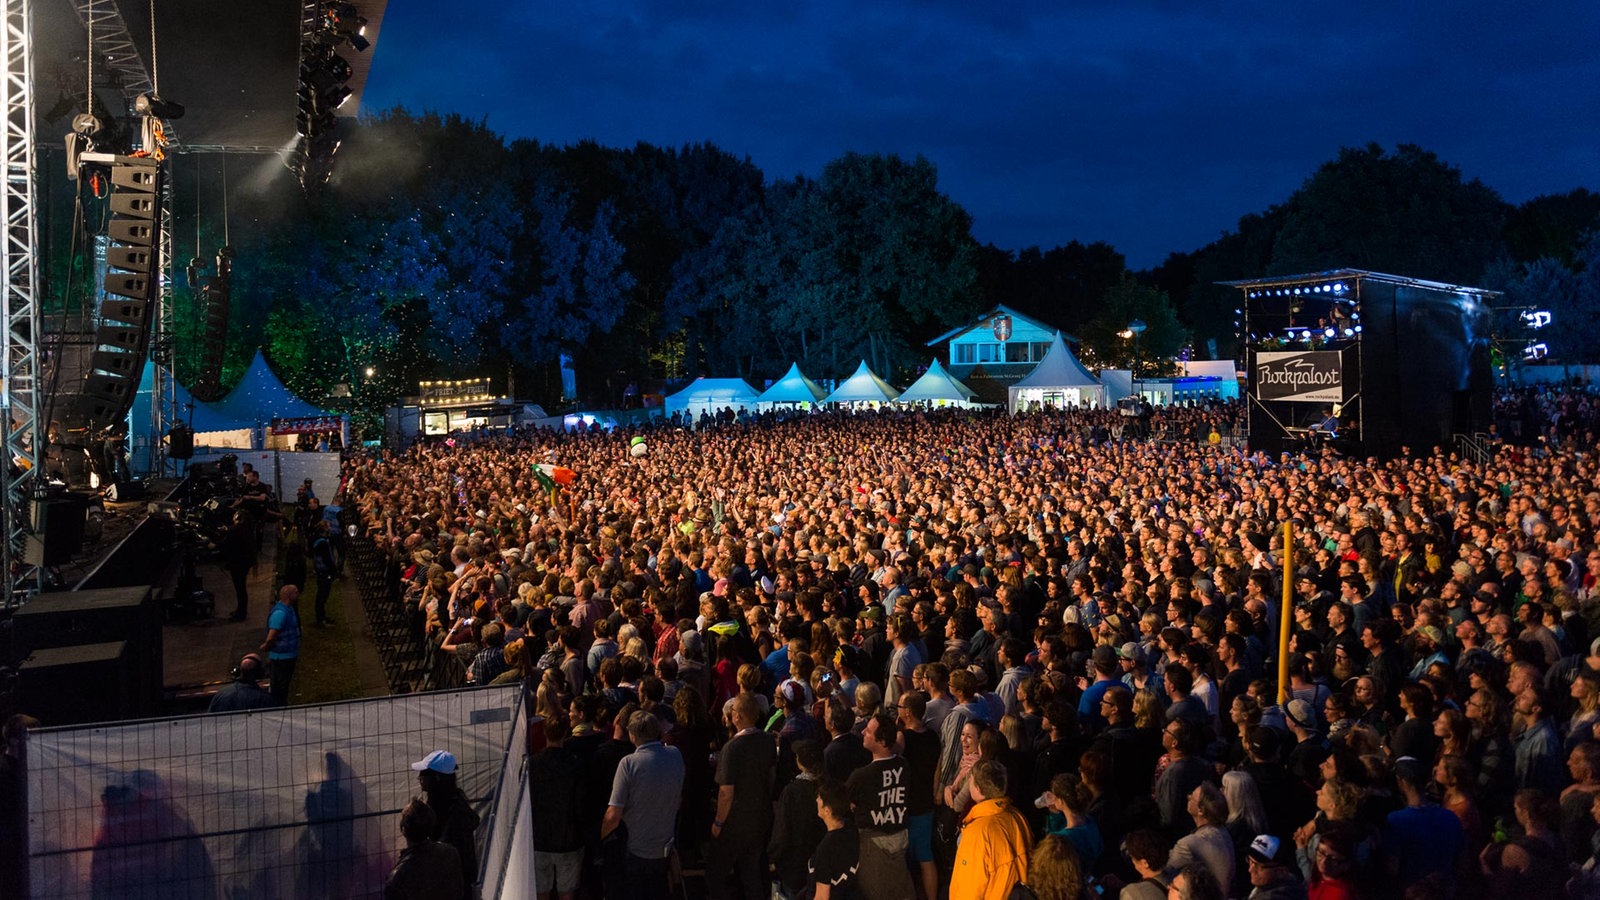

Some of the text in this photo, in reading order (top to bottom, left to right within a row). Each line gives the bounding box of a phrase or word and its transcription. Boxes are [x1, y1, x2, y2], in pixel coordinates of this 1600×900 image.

[1258, 358, 1340, 392] Rockpalast
[434, 387, 454, 396] FRIET
[882, 766, 903, 788] BY
[878, 786, 905, 808] THE
[870, 806, 908, 827] WAY
